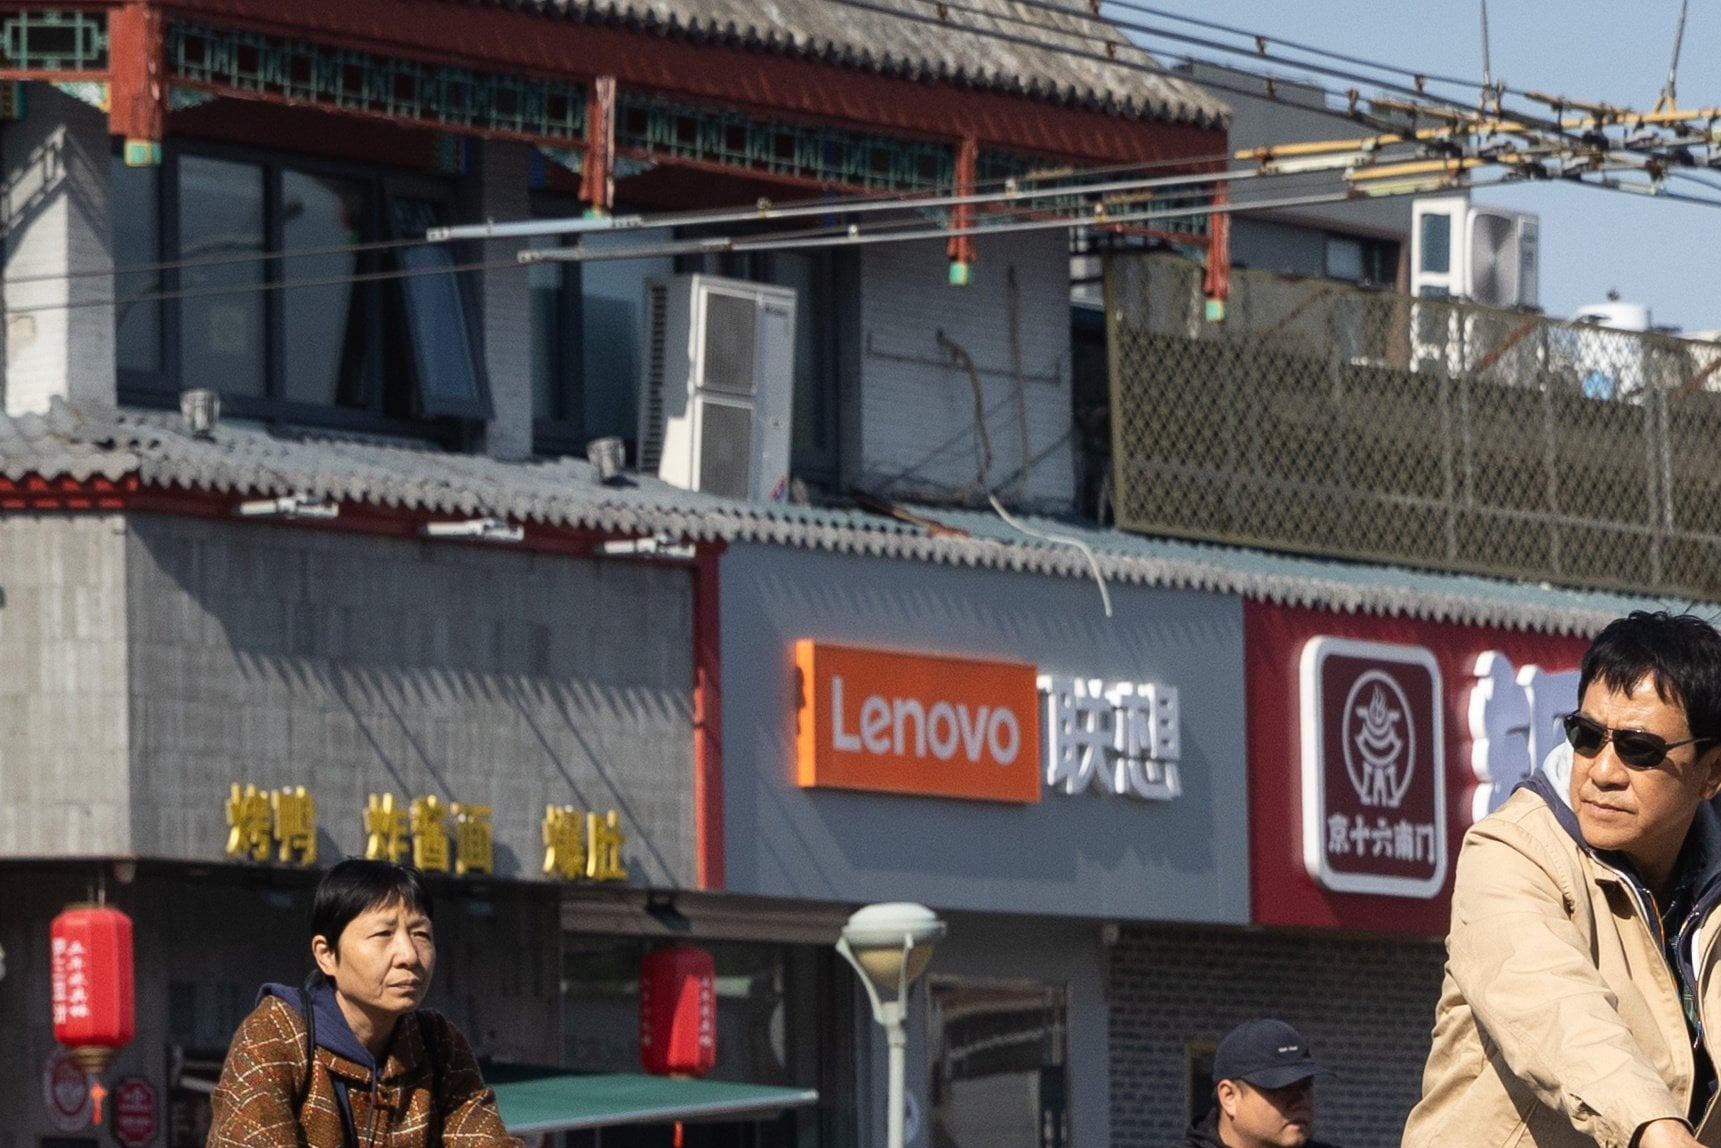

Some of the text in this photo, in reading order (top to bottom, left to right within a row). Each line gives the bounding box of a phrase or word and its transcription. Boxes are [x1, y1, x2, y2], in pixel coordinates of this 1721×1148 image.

[831, 675, 1021, 767] Lenovo
[1037, 673, 1182, 800] 联想
[225, 782, 318, 866] 烤鸭
[363, 792, 495, 876] 炸酱面
